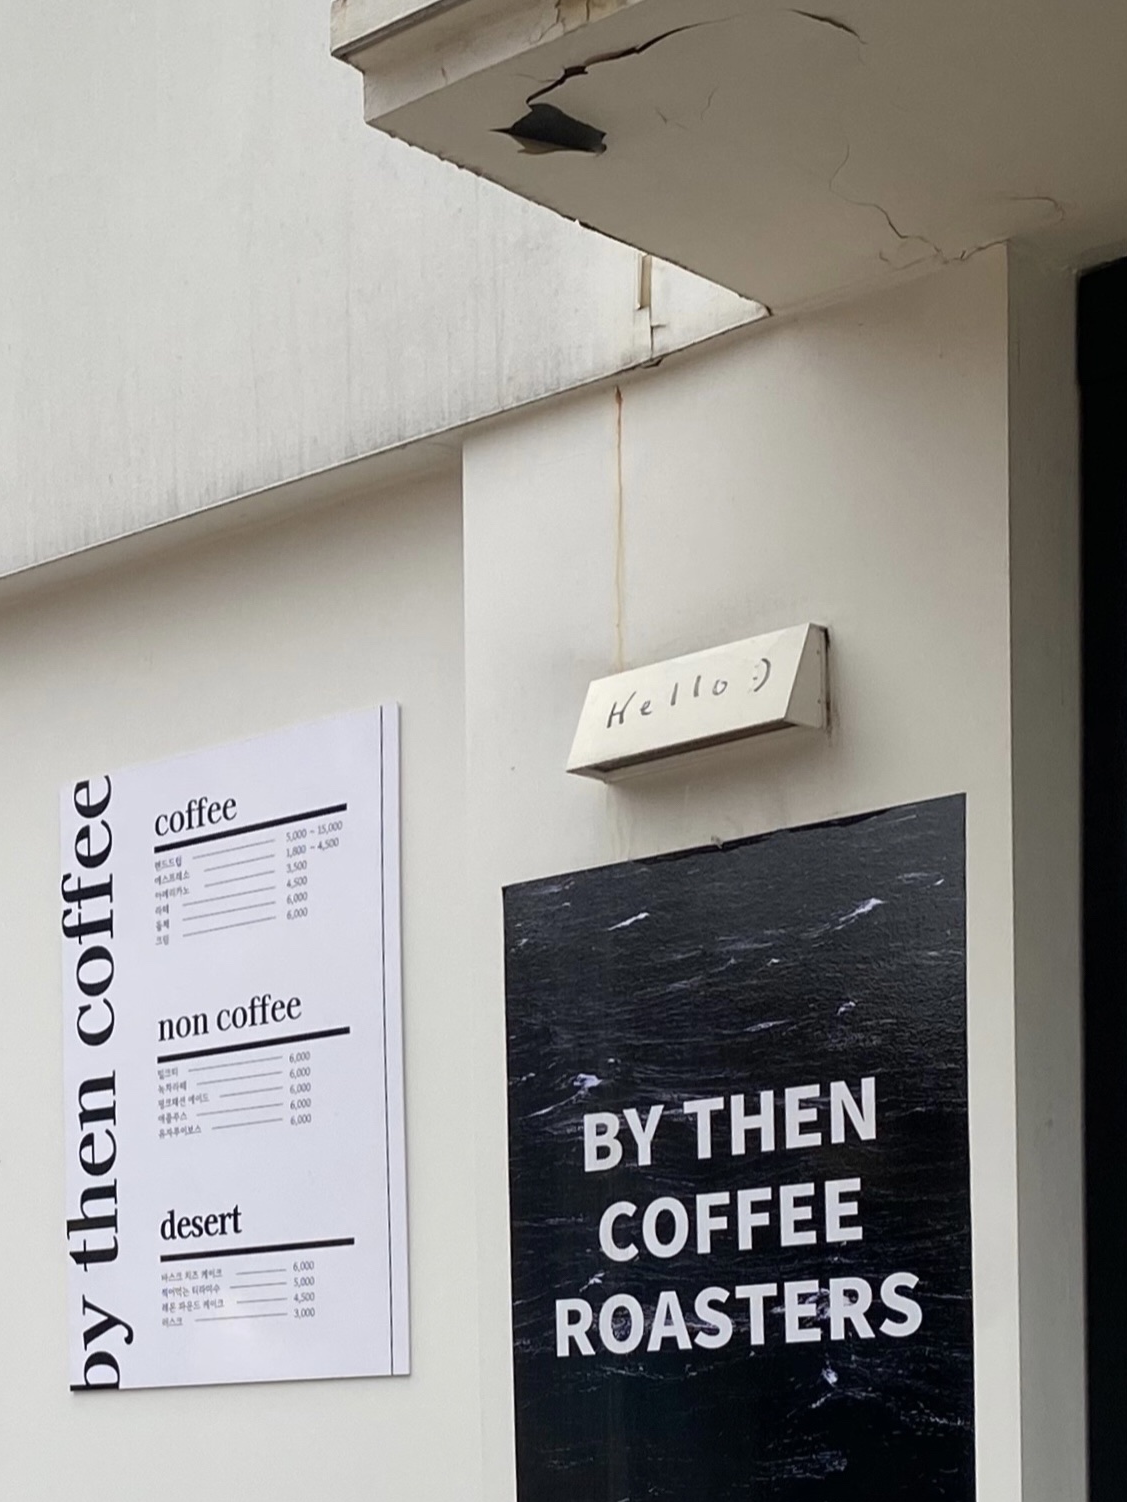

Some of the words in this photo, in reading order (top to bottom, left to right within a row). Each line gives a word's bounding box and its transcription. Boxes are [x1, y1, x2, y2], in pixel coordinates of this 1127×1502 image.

[606, 674, 728, 728] Hello
[154, 796, 238, 837] coffee
[317, 820, 343, 835] 15,000
[317, 837, 340, 851] 4,500
[286, 859, 308, 874] 3,500
[154, 870, 190, 885] 에스프레소
[286, 875, 308, 889] 4,500
[154, 886, 190, 901] 아메리카노
[286, 891, 309, 905] 6,000
[61, 774, 115, 1047] coffee
[286, 907, 309, 921] 6,000
[158, 1013, 209, 1042] non
[216, 993, 303, 1032] coffee
[289, 1051, 311, 1064] 6,000
[289, 1066, 311, 1080] 6,000
[289, 1082, 312, 1095] 6,000
[188, 1092, 210, 1105] 에이드
[290, 1097, 312, 1111] 6,000
[290, 1113, 312, 1126] 6,000
[583, 1104, 665, 1173] BY
[683, 1076, 877, 1160] THEN
[66, 1069, 119, 1273] then
[160, 1204, 243, 1241] desert
[598, 1177, 864, 1262] COFFEE
[293, 1260, 315, 1273] 6,000
[201, 1268, 223, 1280] 케이크
[293, 1276, 315, 1288] 5,000
[203, 1299, 225, 1310] 케이크
[293, 1291, 316, 1304] 4,500
[293, 1307, 316, 1319] 3,000
[555, 1272, 923, 1358] ROASTERS
[69, 1294, 134, 1392] by
